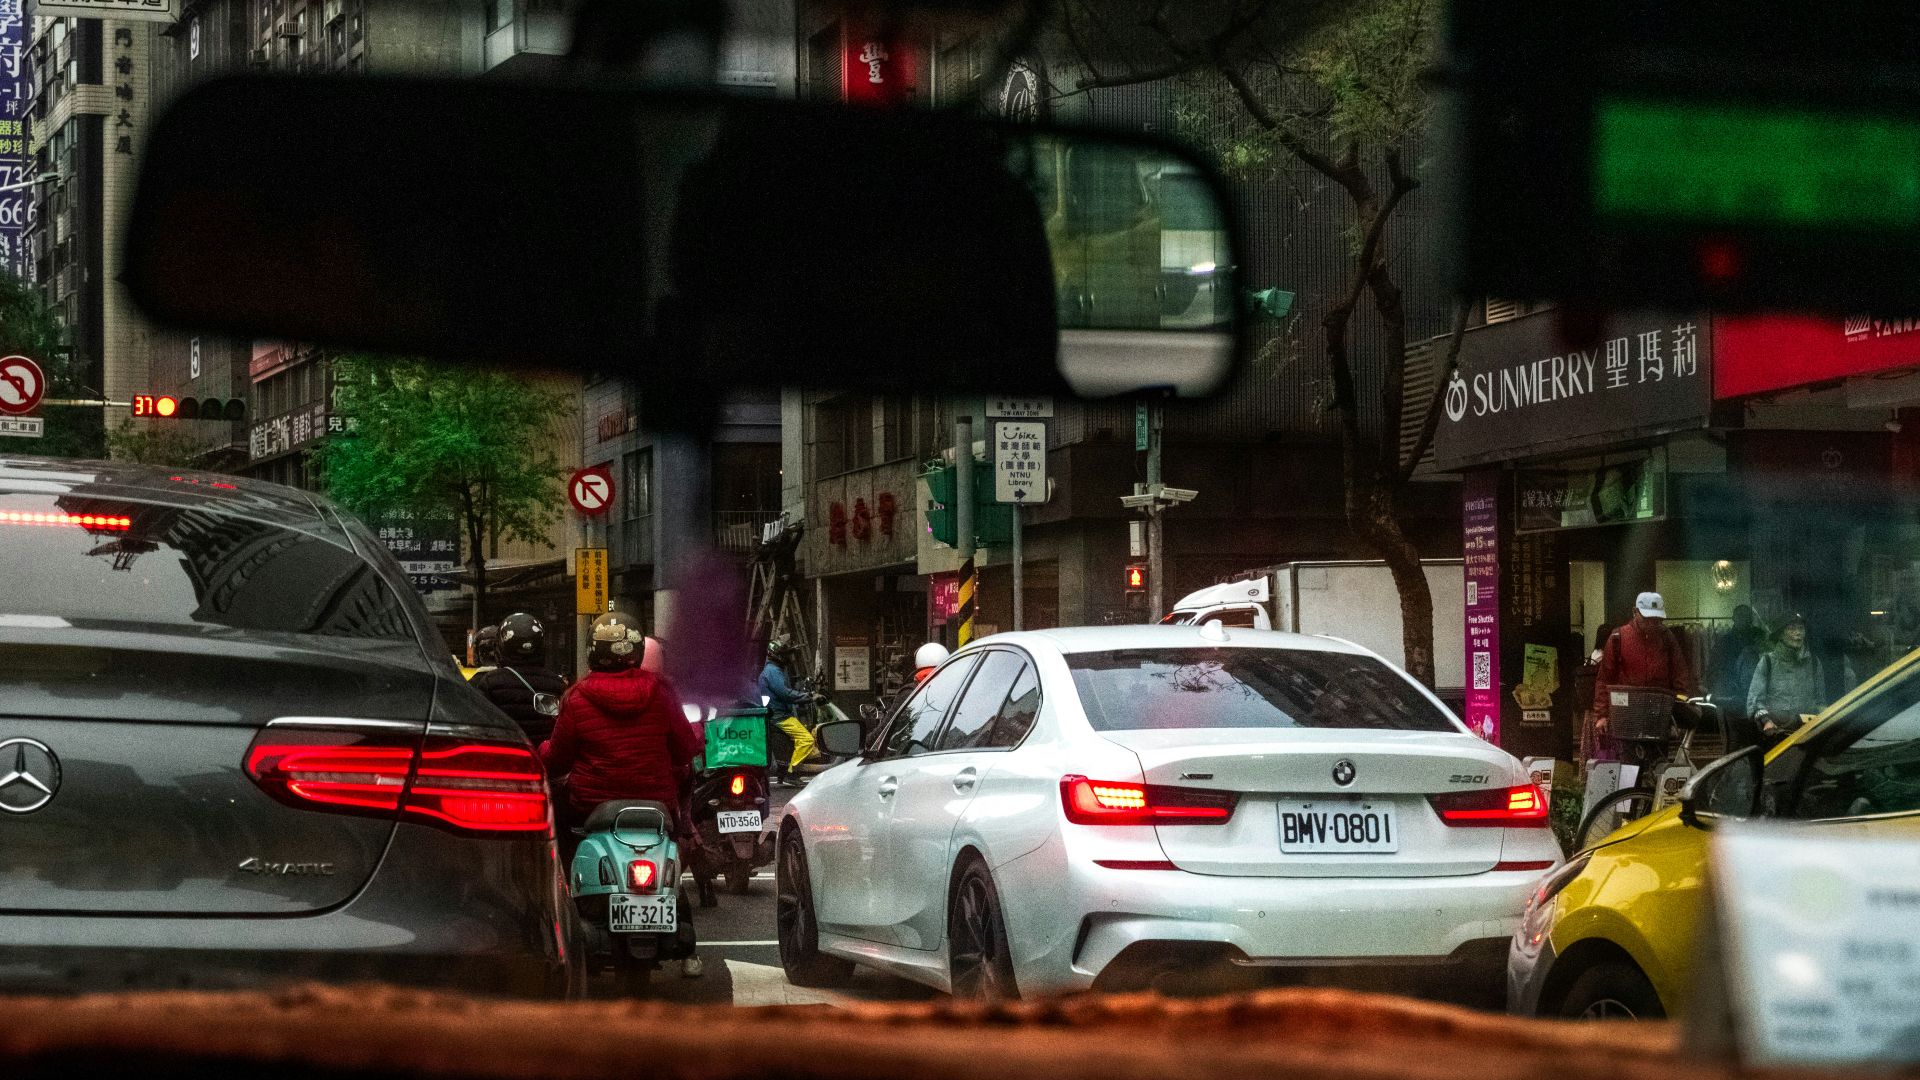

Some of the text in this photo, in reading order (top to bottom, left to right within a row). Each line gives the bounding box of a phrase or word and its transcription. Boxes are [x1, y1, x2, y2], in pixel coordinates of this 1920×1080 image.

[1473, 322, 1697, 417] SUNMERRY 聖瑪莉
[134, 396, 153, 415] 37
[1011, 451, 1031, 460] 大學
[1008, 479, 1033, 487] Library
[1468, 614, 1494, 624] Free Shuttle
[716, 727, 754, 740] Uber
[717, 742, 755, 755] Eats
[1449, 773, 1490, 785] 330i
[239, 857, 335, 875] 4MATIC
